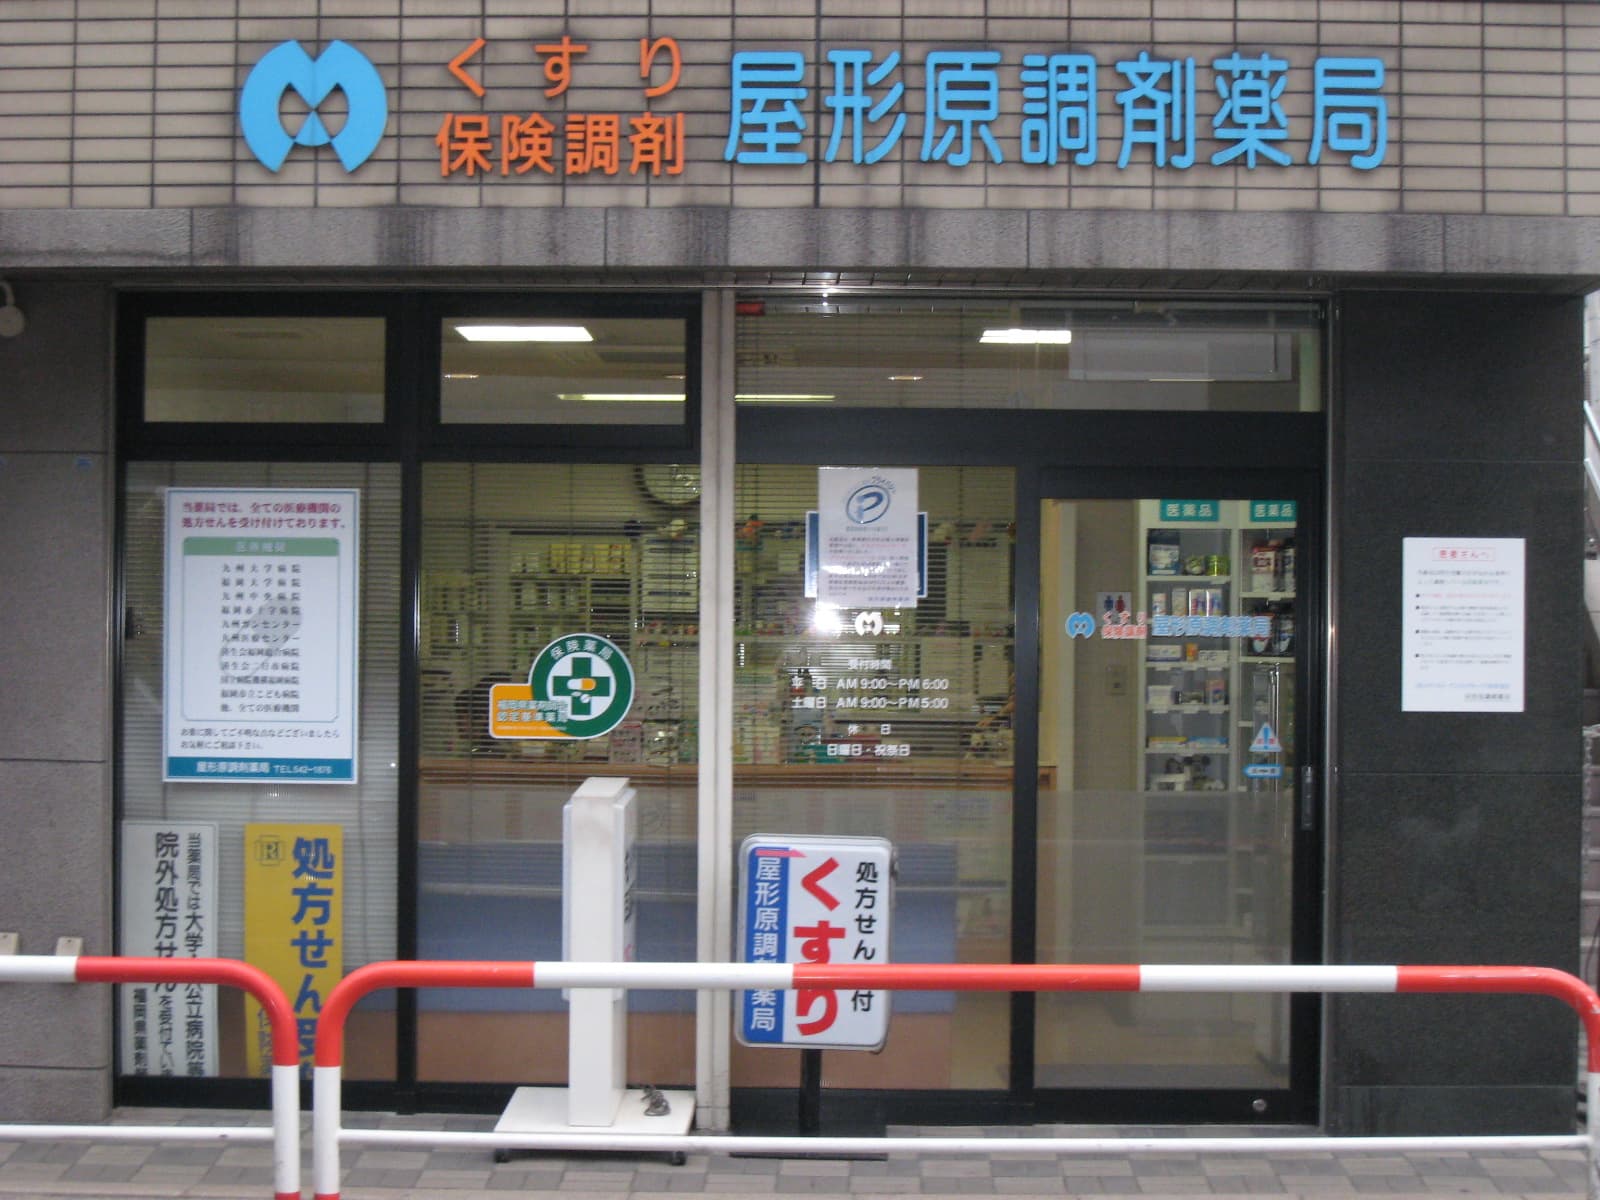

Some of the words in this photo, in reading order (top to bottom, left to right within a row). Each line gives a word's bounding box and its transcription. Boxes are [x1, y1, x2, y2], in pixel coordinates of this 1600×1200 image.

[446, 35, 683, 98] くすり
[724, 49, 1389, 170] 屋形原調剤薬局
[435, 112, 685, 177] 保険調剤
[181, 517, 346, 529] 処方せんを受け付けております。
[1166, 503, 1212, 517] 医薬品
[1255, 503, 1293, 517] 医薬品
[792, 696, 827, 708] 土曜日
[751, 857, 782, 1032] 屋形原調薬局
[793, 857, 846, 1036] くすり
[851, 861, 878, 1012] 処方せん付
